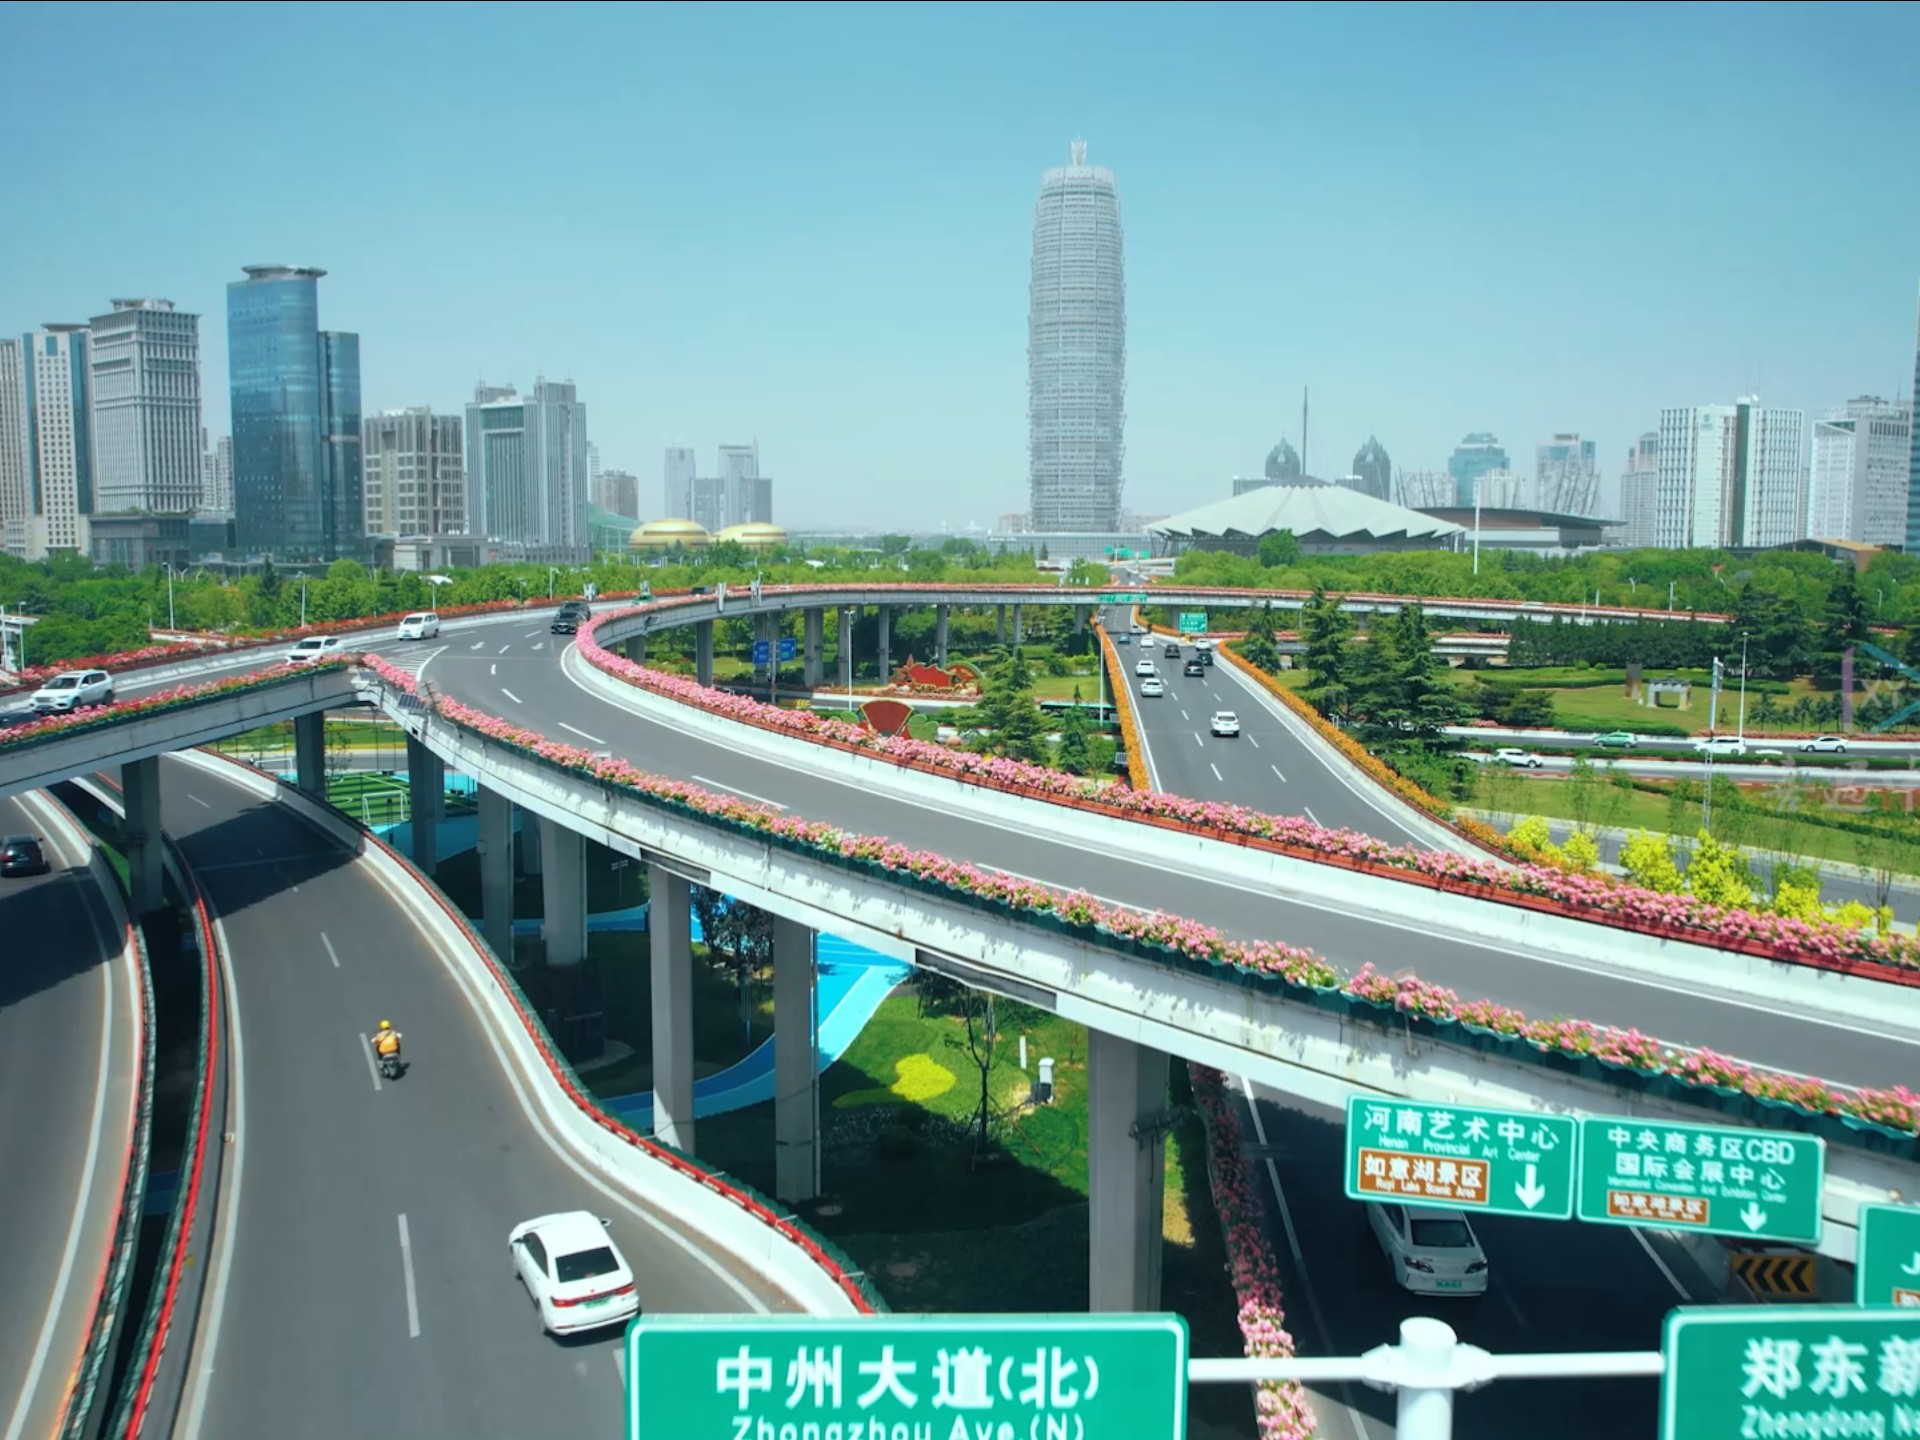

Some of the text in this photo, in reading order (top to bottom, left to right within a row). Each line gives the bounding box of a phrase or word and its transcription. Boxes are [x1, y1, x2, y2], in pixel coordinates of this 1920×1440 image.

[1364, 1104, 1559, 1150] 河南艺术中心
[1608, 1126, 1795, 1165] 中央商务区CBD
[1378, 1134, 1541, 1163] Henan Provincial Art Center
[1364, 1153, 1482, 1189] 如意湖景区
[1616, 1152, 1786, 1191] 国际会展中心
[717, 1344, 1100, 1411] 中州大道(北)
[732, 1412, 1085, 1440] Zhongzhou Ave(N)
